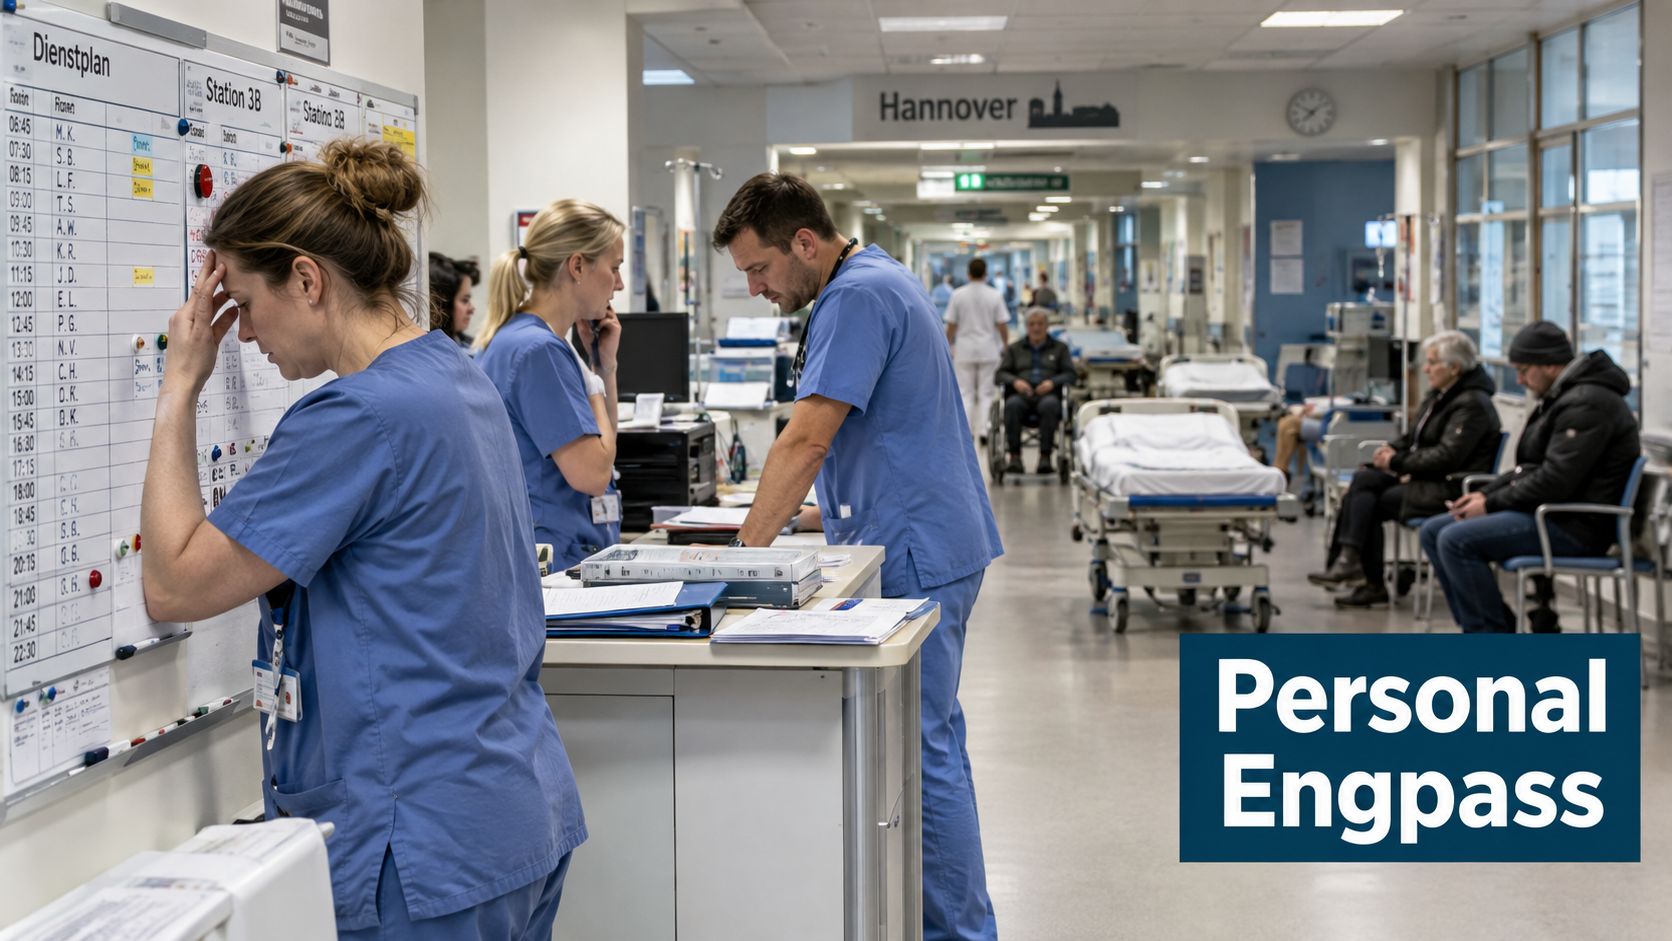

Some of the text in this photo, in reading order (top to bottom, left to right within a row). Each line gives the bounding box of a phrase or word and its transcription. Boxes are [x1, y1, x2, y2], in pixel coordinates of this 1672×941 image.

[33, 31, 111, 78] Dienstplan
[206, 76, 245, 109] Station
[879, 91, 1018, 121] Hannover
[9, 140, 31, 160] 07:30
[11, 265, 33, 283] 11:15
[11, 290, 33, 308] 12:00
[11, 315, 33, 333] 12:45
[12, 365, 34, 383] 14:15
[12, 389, 34, 407] 15:00
[12, 411, 34, 431] 15:45
[13, 434, 35, 453] 16:30
[13, 458, 35, 478] 17:15
[13, 613, 36, 638] 21:45
[13, 640, 36, 664] 22:30
